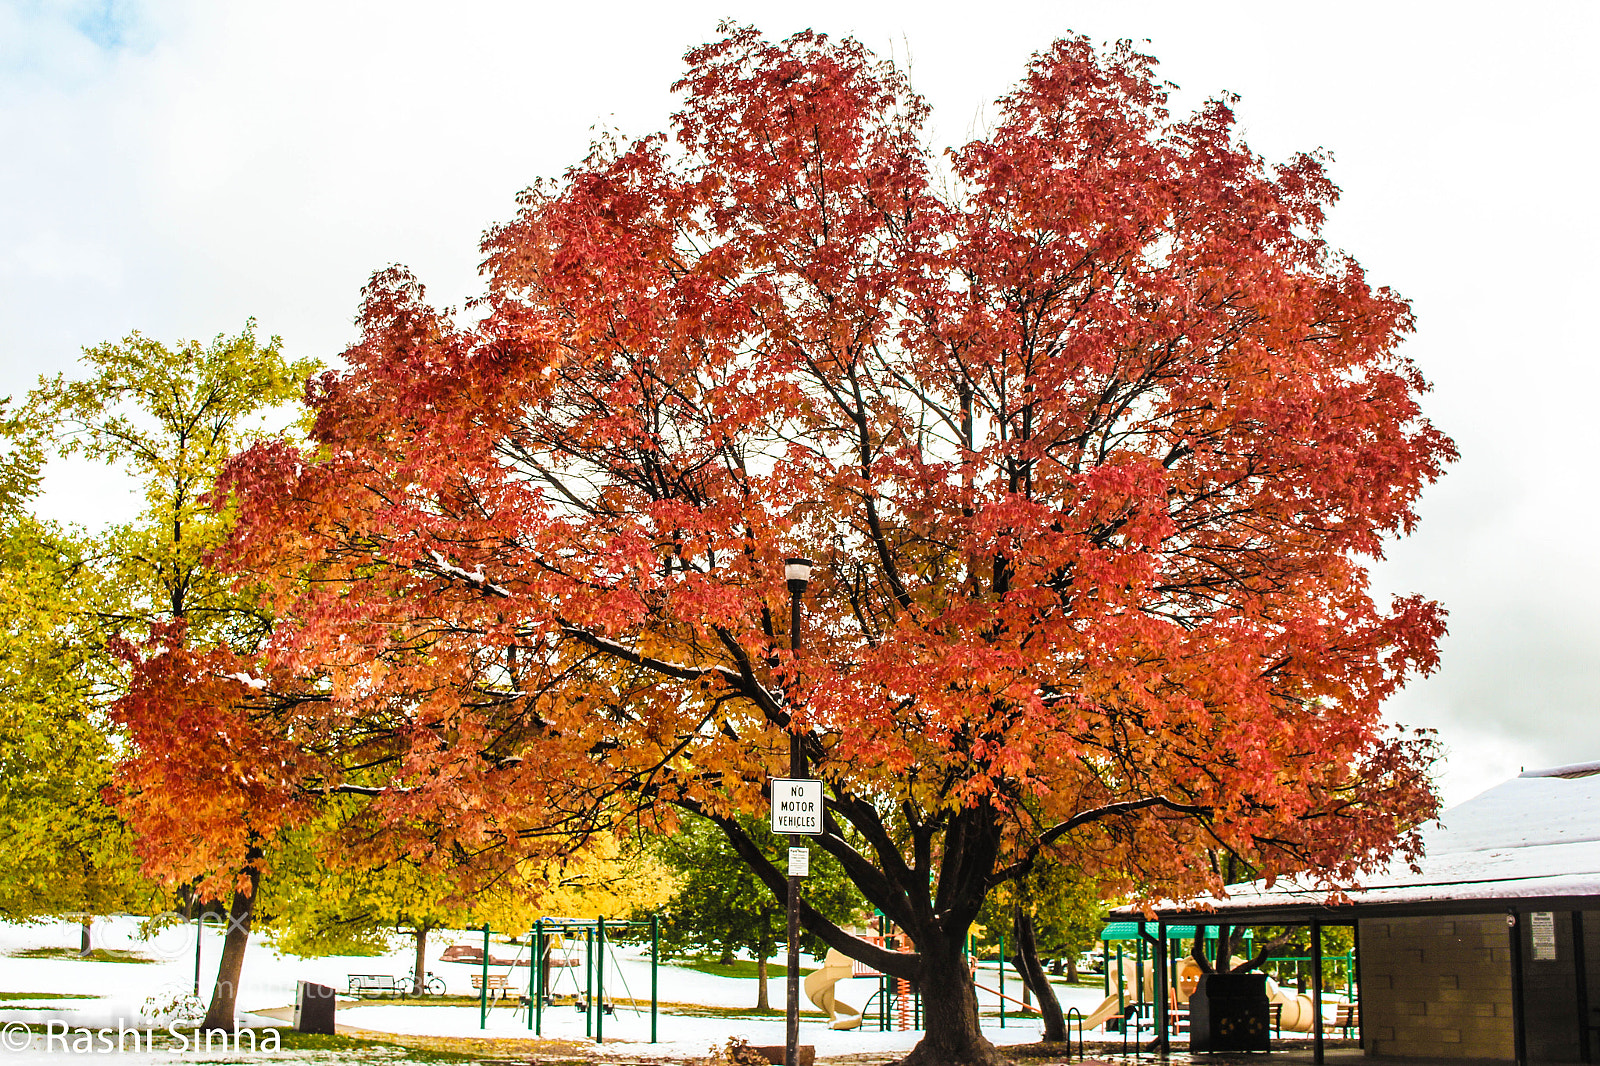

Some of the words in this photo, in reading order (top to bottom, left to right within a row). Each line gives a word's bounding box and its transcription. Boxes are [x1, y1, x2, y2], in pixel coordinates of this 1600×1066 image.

[791, 787, 804, 797] NO
[781, 801, 814, 812] MOTOR
[779, 816, 816, 827] VEHICLES
